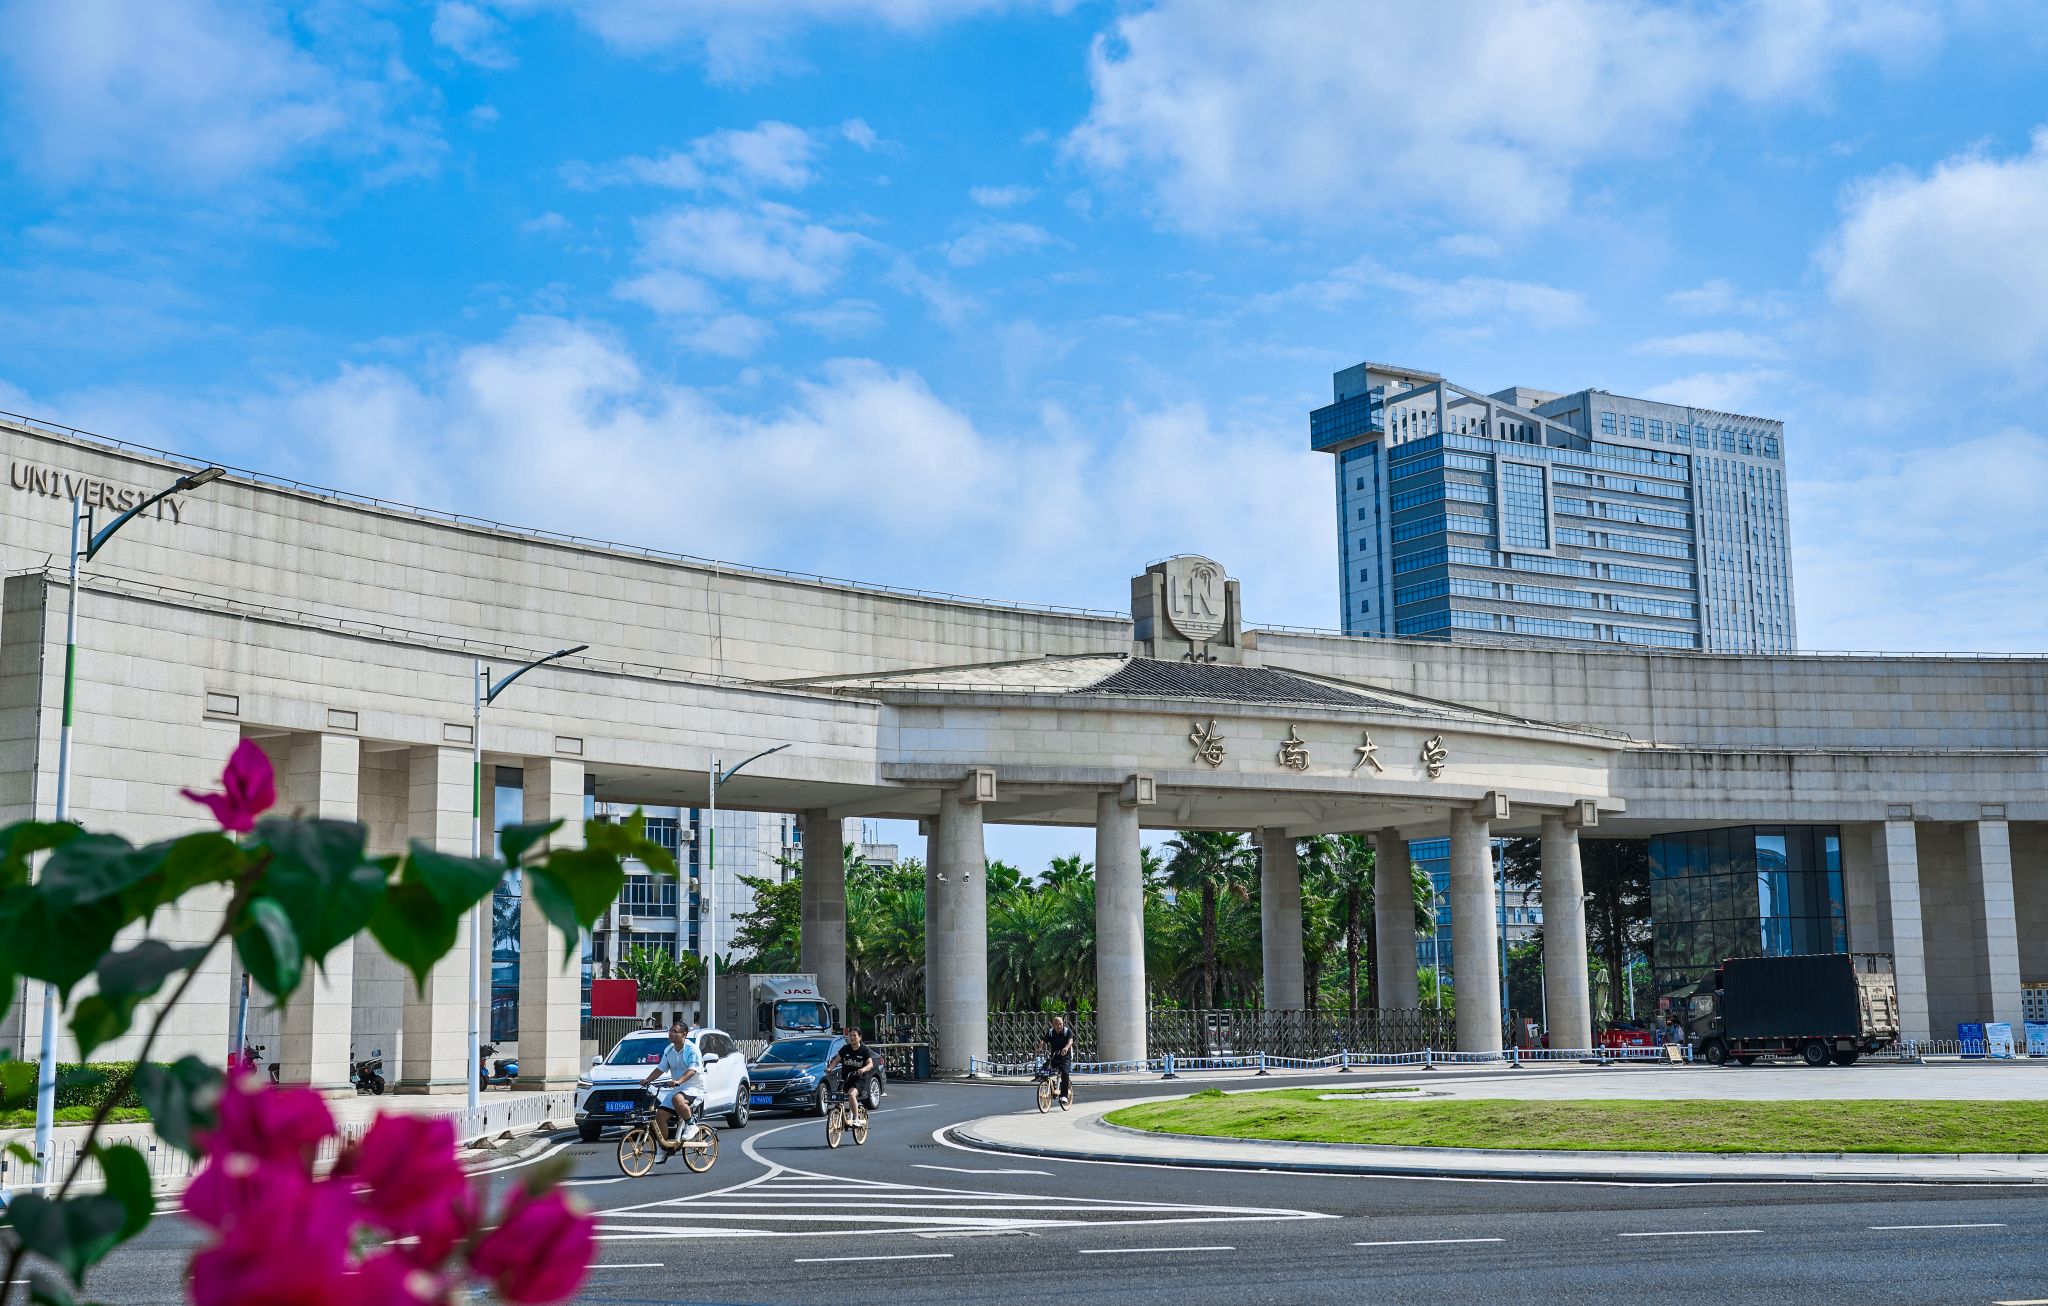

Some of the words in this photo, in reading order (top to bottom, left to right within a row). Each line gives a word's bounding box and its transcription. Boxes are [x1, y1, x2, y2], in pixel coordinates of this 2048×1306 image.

[10, 461, 186, 525] UNIVERSITY
[1189, 720, 1450, 778] 海南大学
